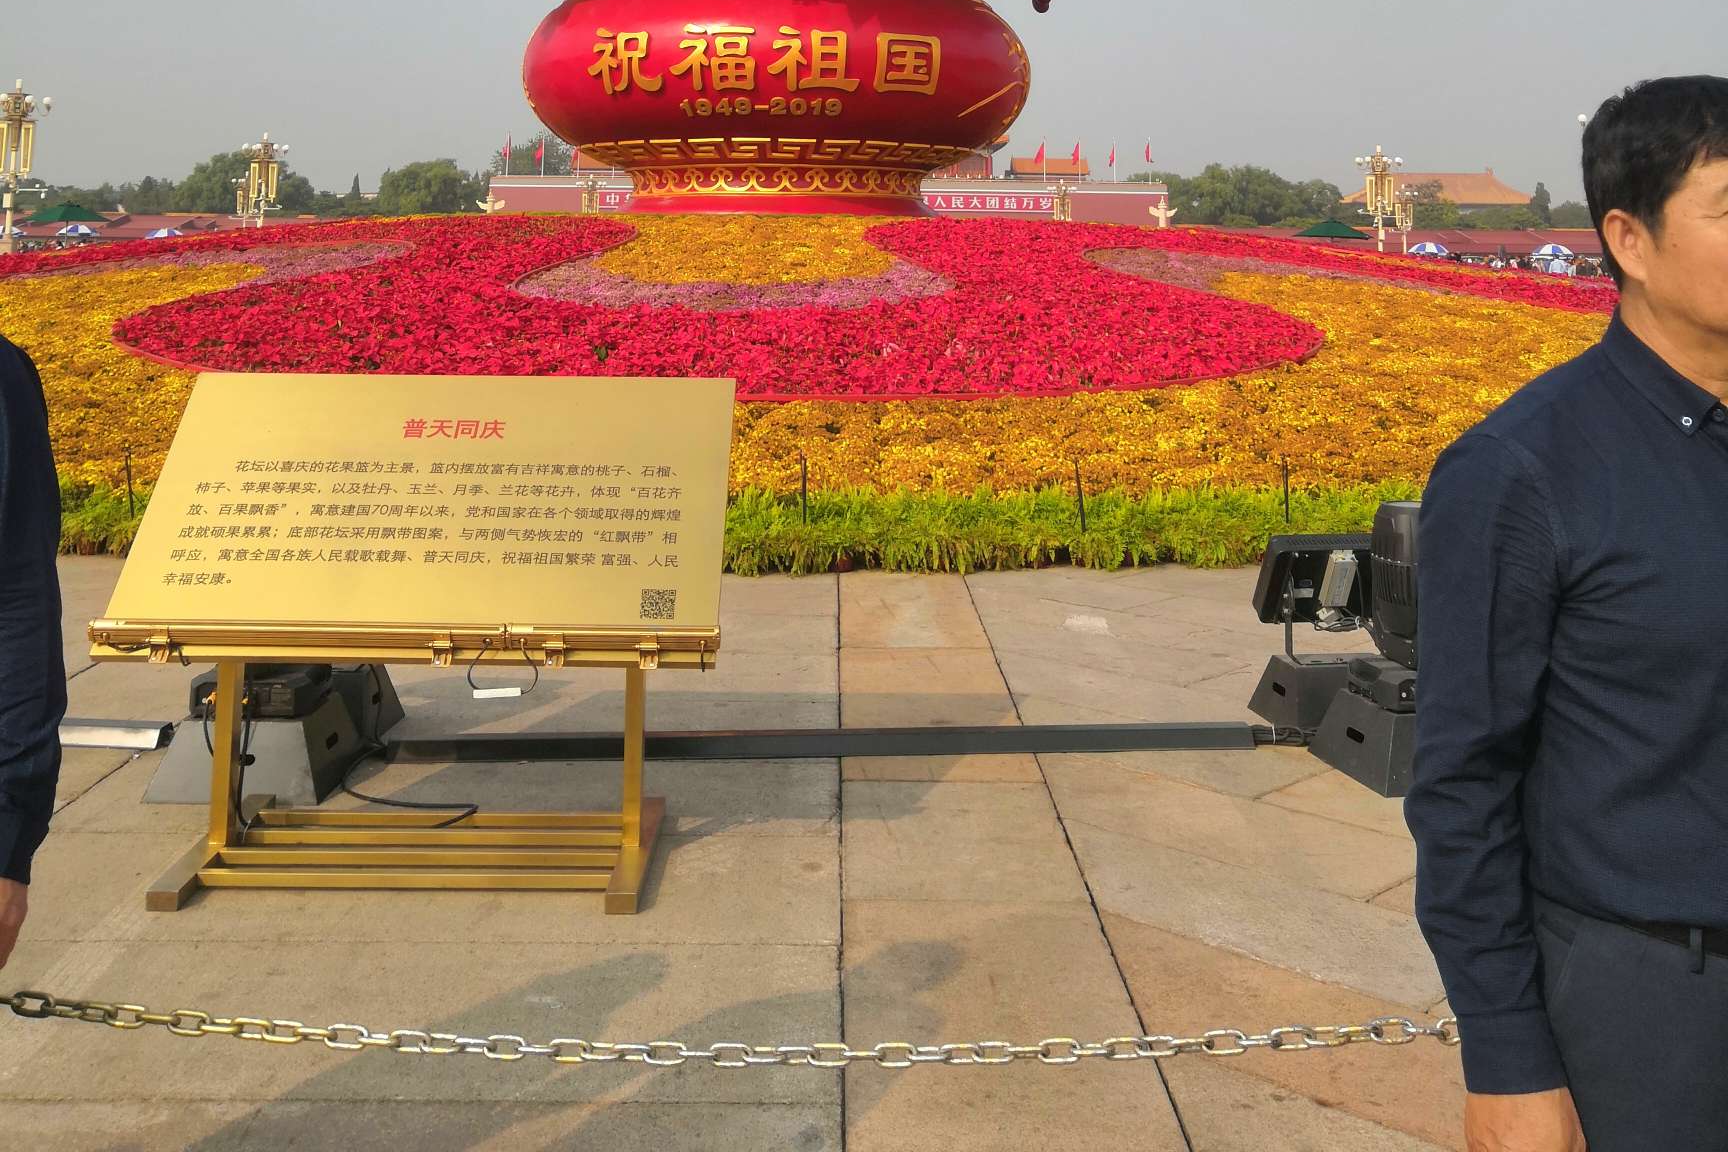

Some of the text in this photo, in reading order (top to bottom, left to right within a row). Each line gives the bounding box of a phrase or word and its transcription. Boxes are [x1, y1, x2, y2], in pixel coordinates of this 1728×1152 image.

[587, 23, 941, 95] 祝福祖国
[403, 418, 506, 439] 普天同庆
[161, 572, 232, 586] 幸福安康。
